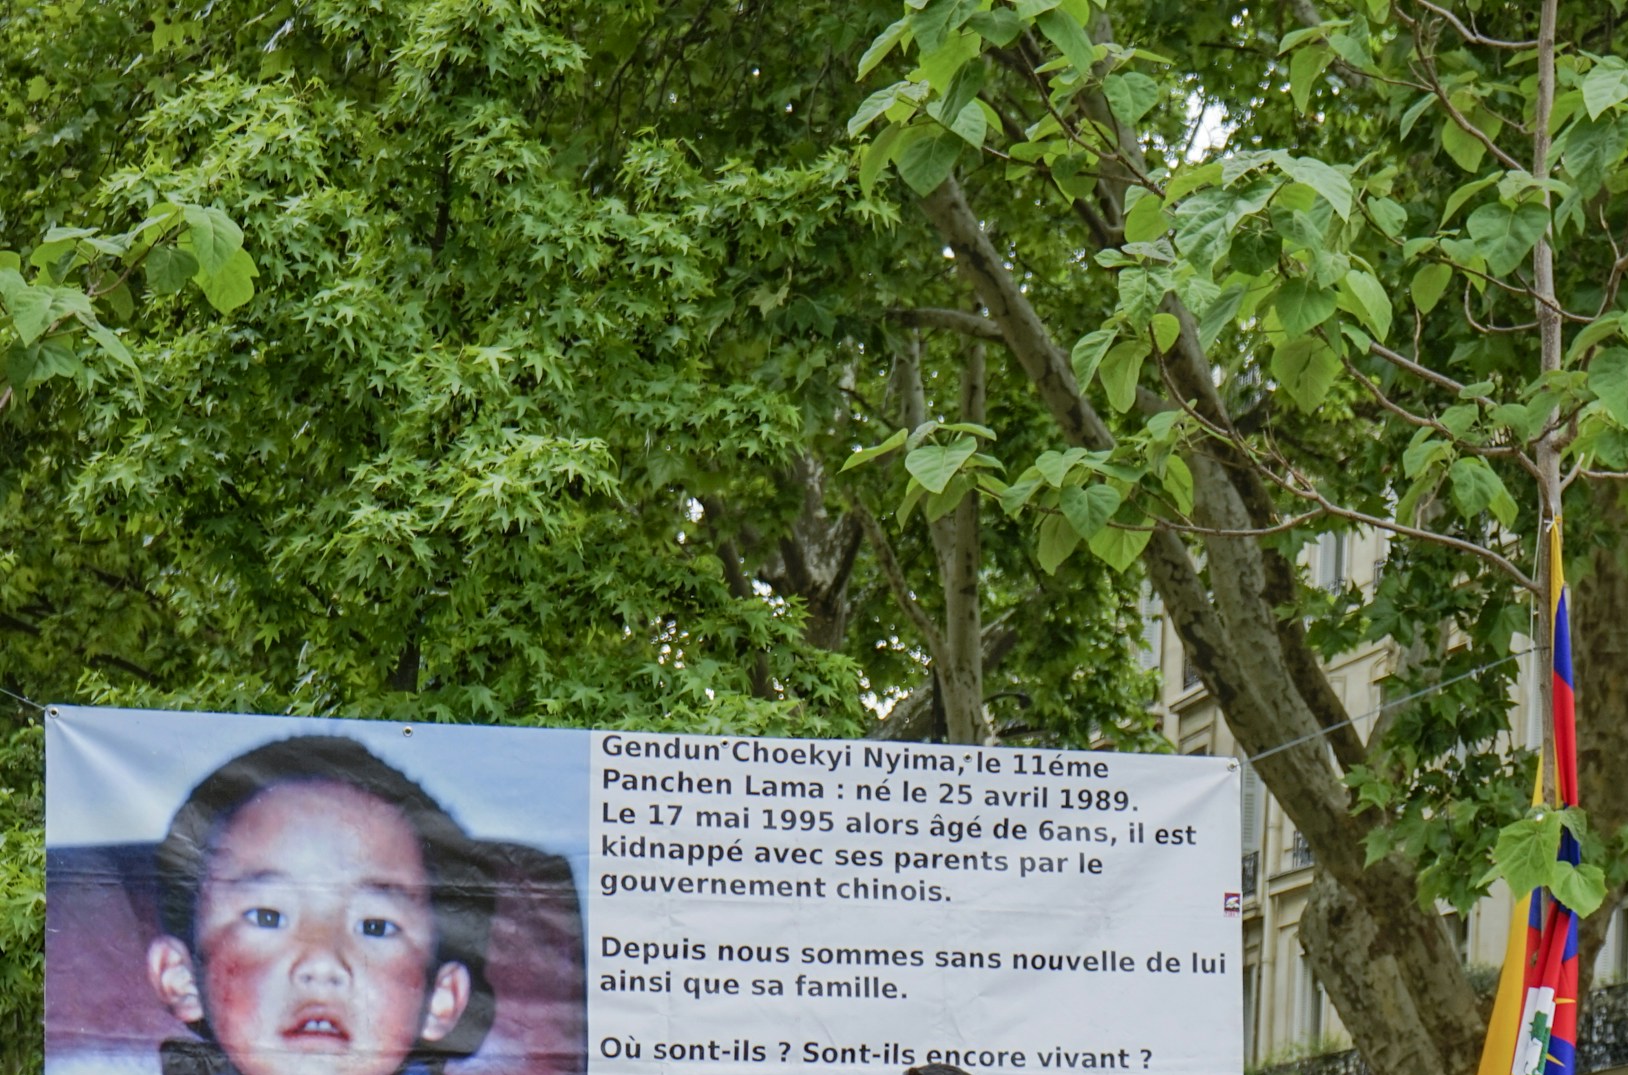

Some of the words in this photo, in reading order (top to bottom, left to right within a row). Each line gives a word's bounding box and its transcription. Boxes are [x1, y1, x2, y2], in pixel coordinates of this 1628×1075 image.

[602, 735, 720, 761] Gendun
[732, 741, 851, 772] Choekyi
[864, 747, 965, 776] Nyima,
[977, 751, 1001, 774] le
[1013, 753, 1109, 778] 11éme
[602, 769, 732, 796] Panchen
[746, 775, 825, 799] Lama
[857, 779, 891, 801] né
[903, 780, 927, 804] le
[939, 783, 973, 805] 25
[985, 785, 1048, 808] avril
[1060, 789, 1139, 812] 1989.
[602, 802, 636, 825] Le
[648, 804, 683, 826] 17
[697, 806, 750, 829] mai
[763, 809, 835, 833] 1995
[846, 812, 919, 836] alors
[930, 814, 983, 841] âgé
[993, 818, 1028, 841] de
[1038, 820, 1117, 846] 6ans,
[1129, 822, 1144, 845] il
[1155, 826, 1197, 846] est
[602, 835, 744, 867] kidnappé
[755, 846, 824, 866] avec
[835, 849, 884, 868] ses
[895, 850, 1009, 874] parents
[1020, 857, 1068, 877] par
[1080, 852, 1103, 875] le
[601, 874, 826, 899] gouvernement
[836, 877, 952, 902] chinois.
[602, 936, 707, 966] Depuis
[718, 945, 790, 964] nous
[802, 947, 924, 966] sommes
[936, 951, 1002, 970] sans
[1013, 950, 1136, 973] nouvelle
[1146, 951, 1181, 974] de
[1192, 952, 1226, 975] lui
[600, 970, 672, 994] ainsi
[684, 977, 740, 1000] que
[752, 979, 784, 997] sa
[795, 974, 908, 999] famille.
[600, 1035, 641, 1060] Où
[654, 1040, 766, 1063] sont-ils
[779, 1042, 792, 1063] ?
[803, 1042, 915, 1065] Sont-ils
[926, 1047, 1026, 1067] encore
[1037, 1047, 1130, 1069] vivant
[1140, 1048, 1153, 1069] ?
